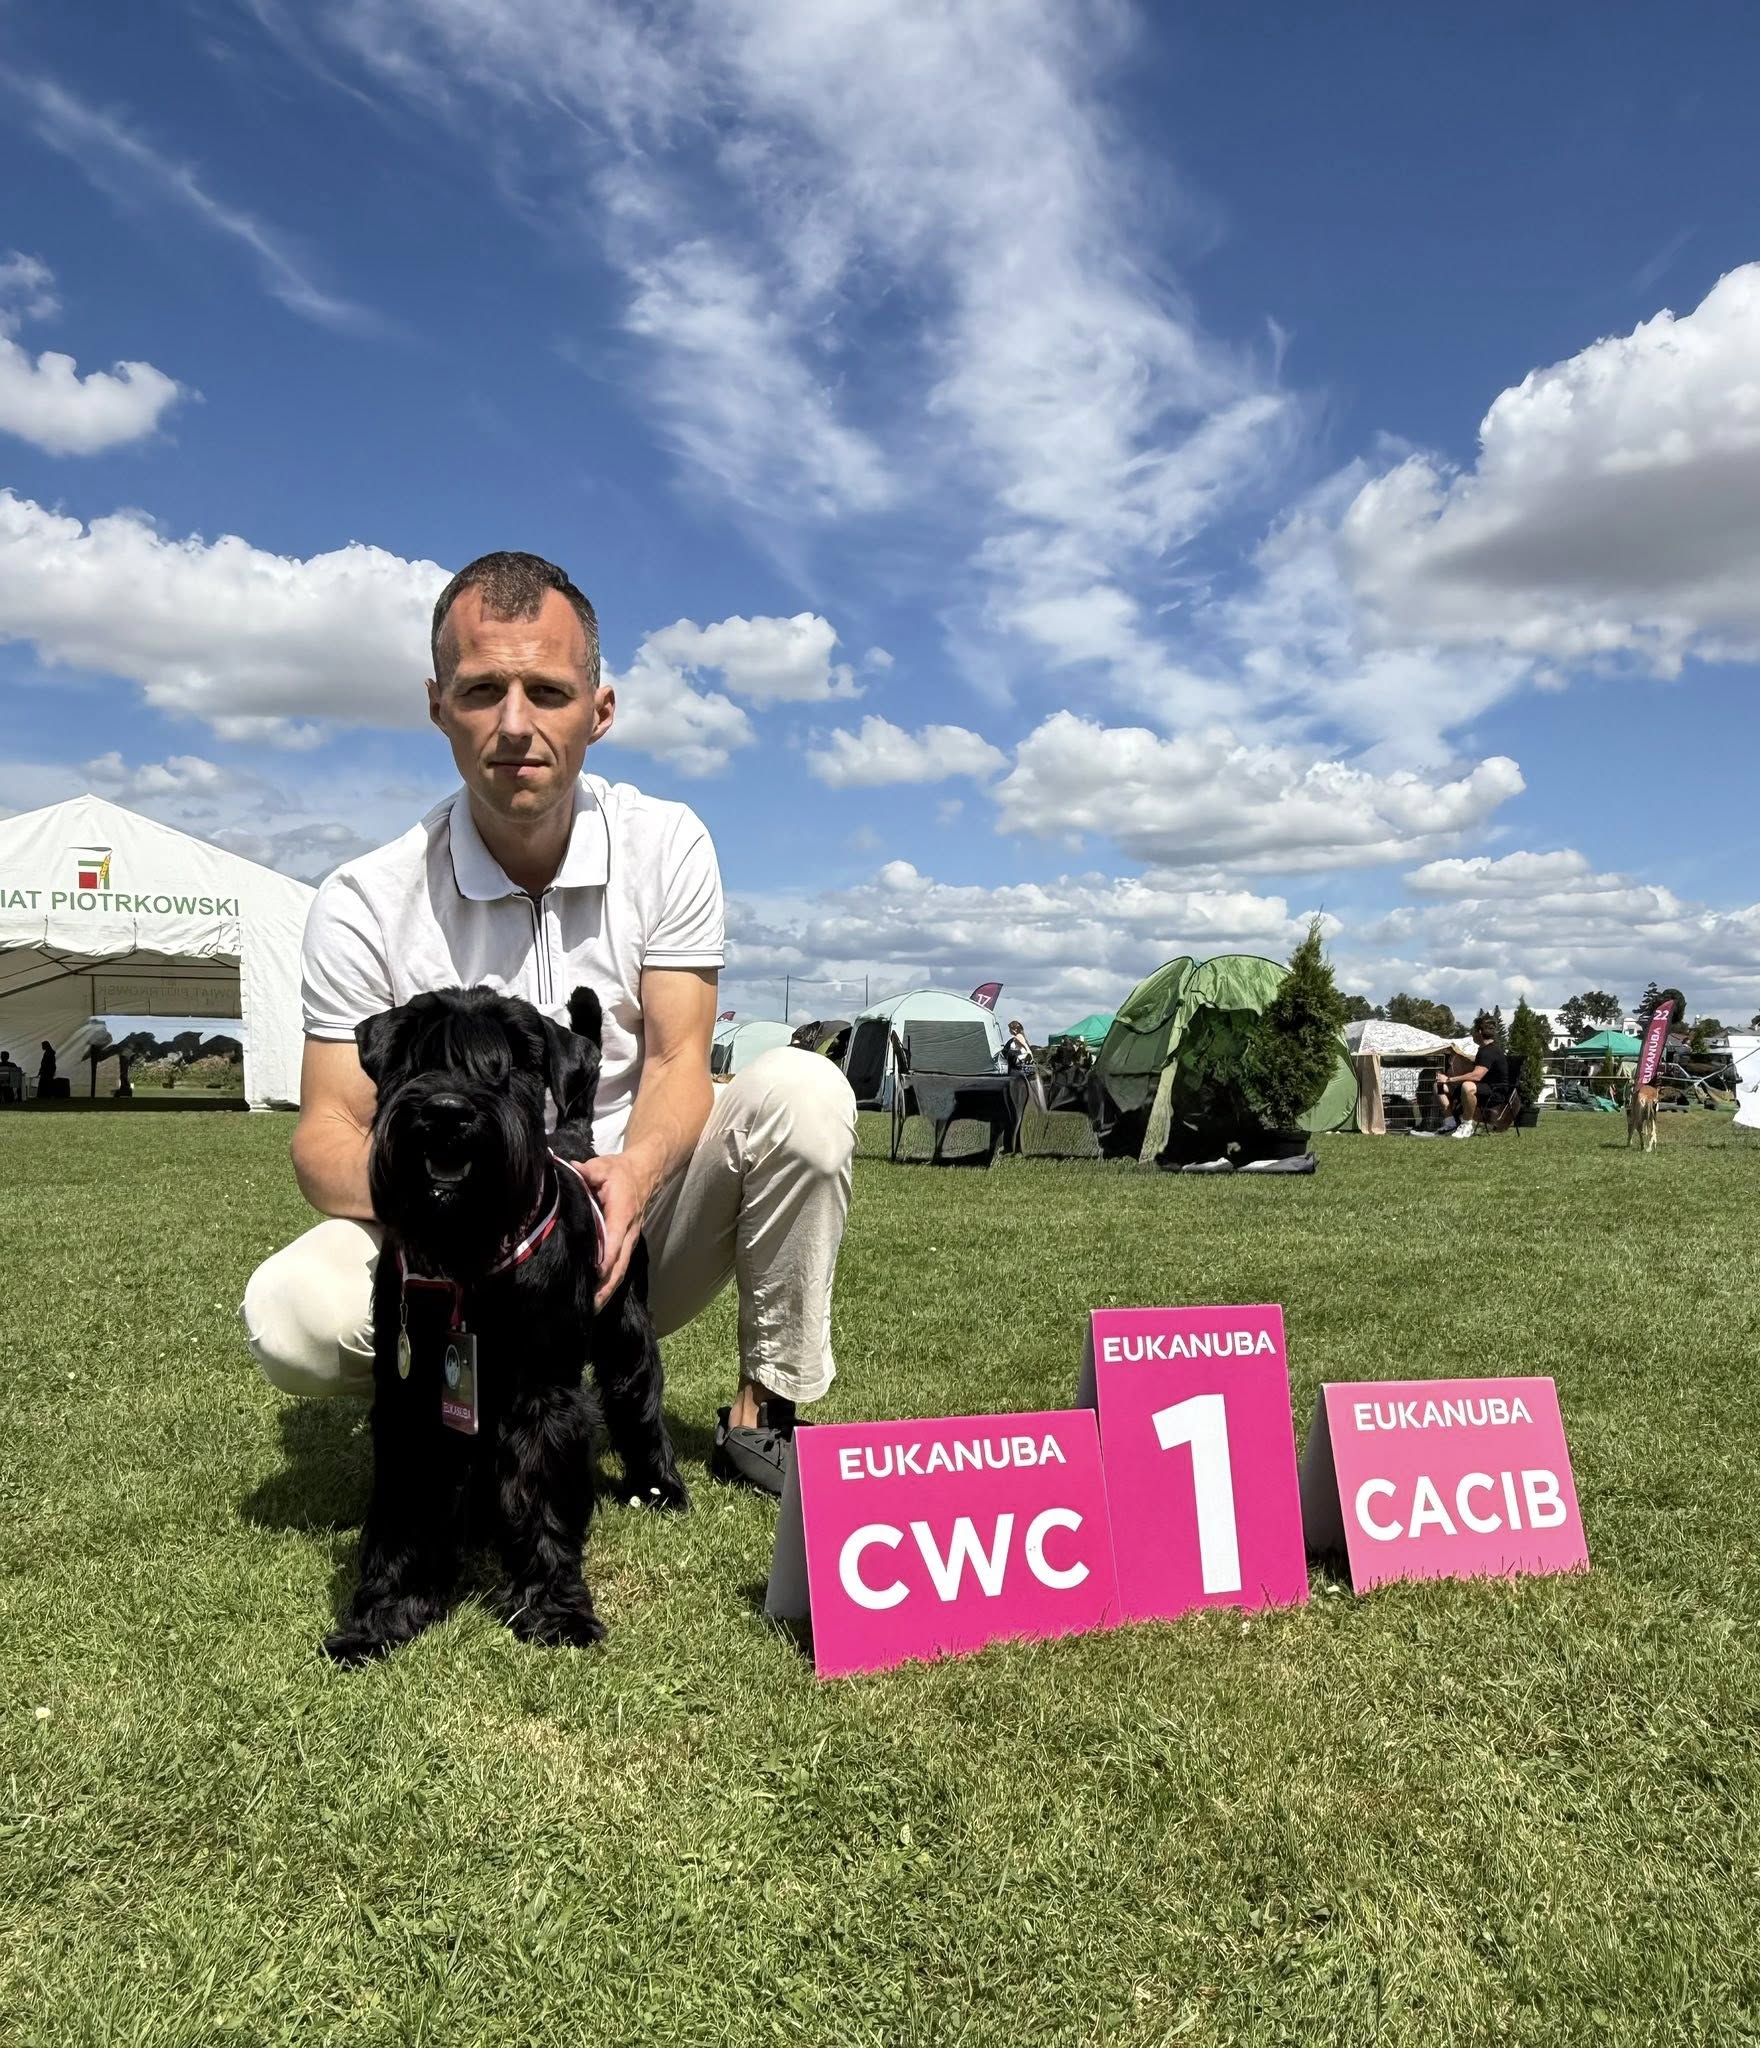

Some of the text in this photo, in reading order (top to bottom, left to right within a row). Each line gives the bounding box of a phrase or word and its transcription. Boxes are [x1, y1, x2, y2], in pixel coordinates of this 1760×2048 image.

[51, 891, 240, 917] PIOTRKOWSKI
[977, 993, 991, 1007] 17
[1653, 1010, 1669, 1021] 22
[1642, 1027, 1661, 1084] EUKANUBA
[1104, 1331, 1276, 1363] EUKANUBA
[1354, 1397, 1533, 1432] EUKANUBA
[840, 1435, 1067, 1481] EUKANUBA
[1152, 1394, 1242, 1595] 1
[1355, 1469, 1567, 1542] CACIB
[839, 1507, 1090, 1610] CWC
